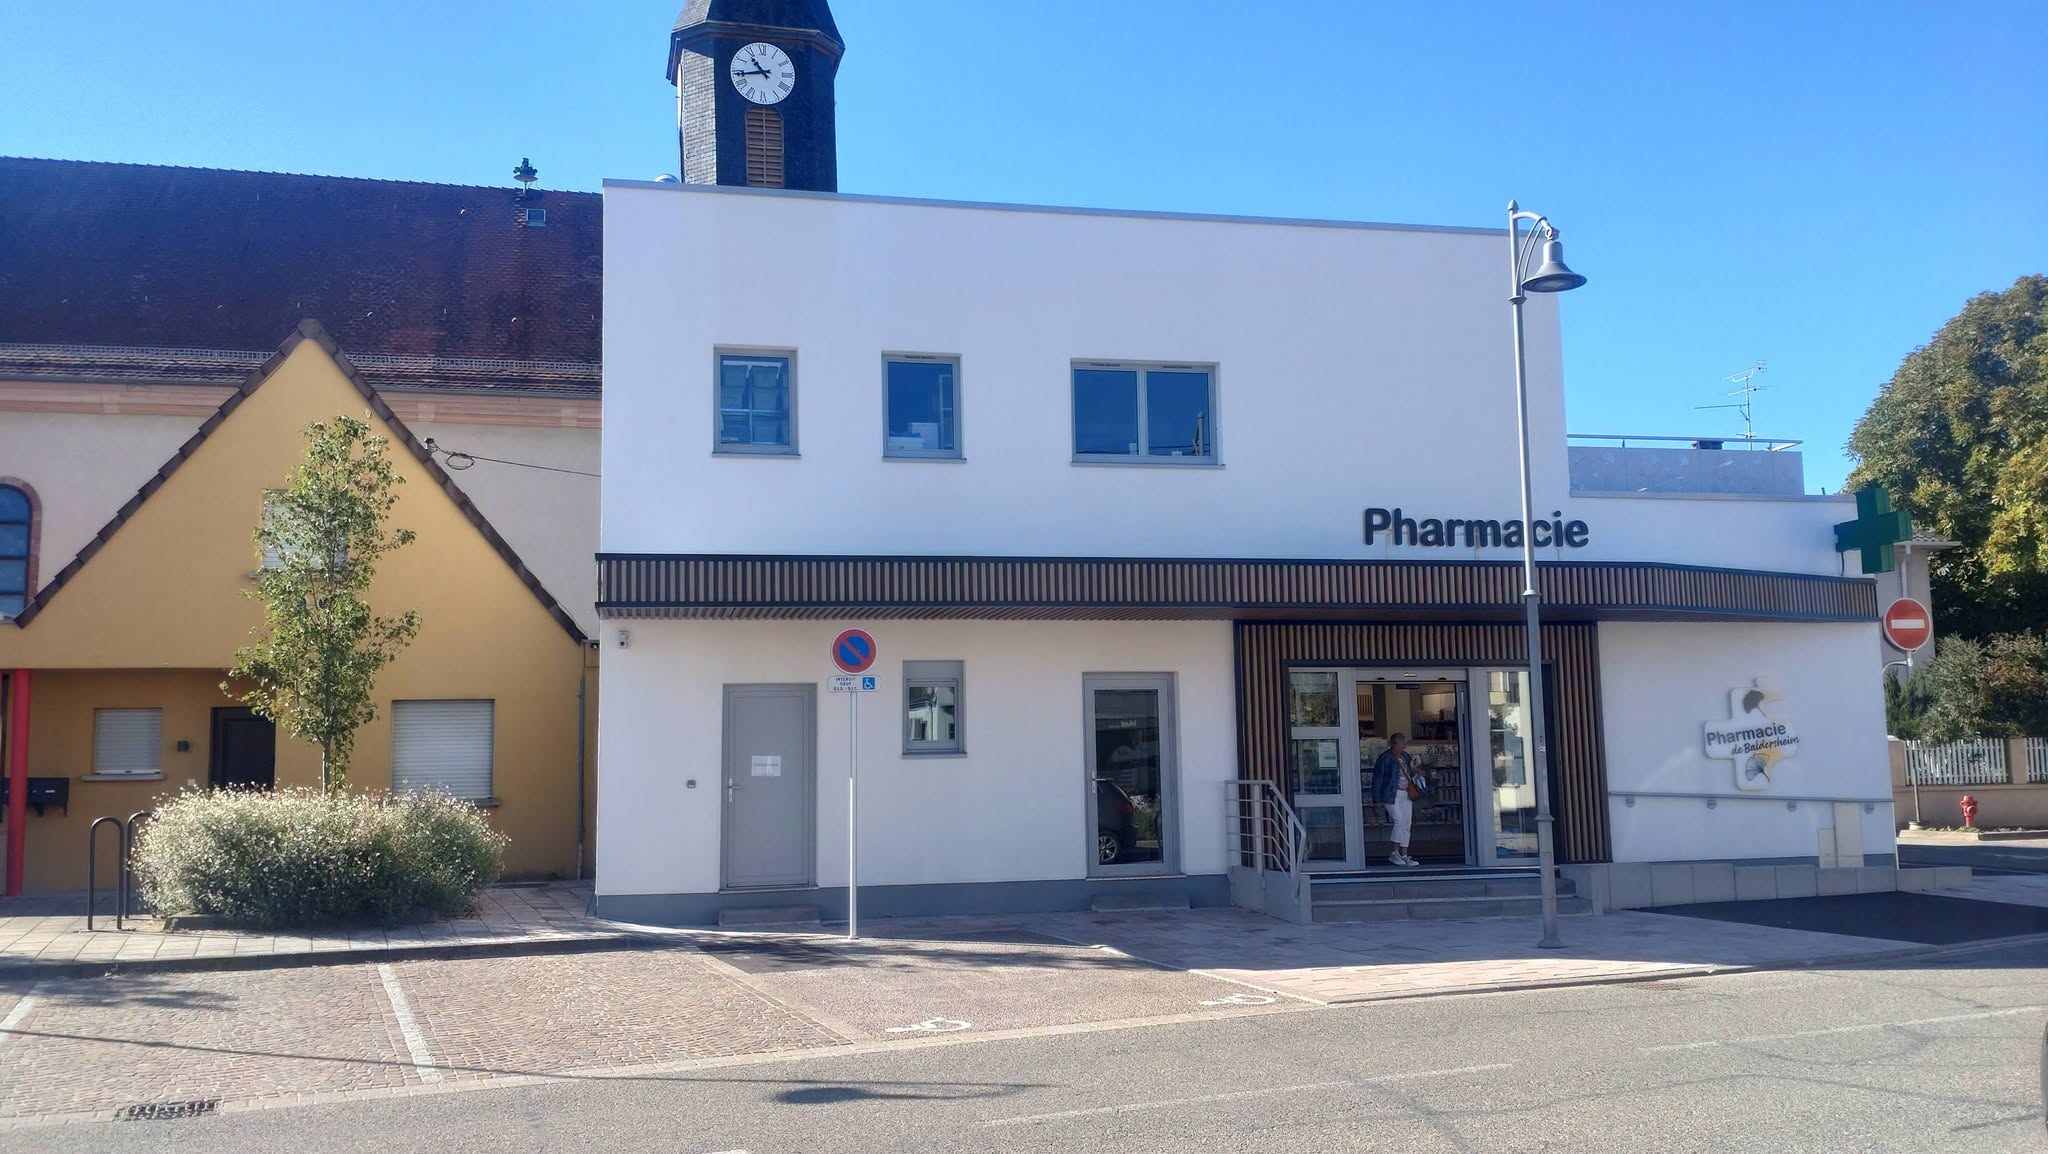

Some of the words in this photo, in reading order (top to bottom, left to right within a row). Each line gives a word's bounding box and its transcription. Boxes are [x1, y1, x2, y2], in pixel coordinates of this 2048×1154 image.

[1364, 507, 1589, 548] Pharmacie
[1706, 723, 1786, 746] Pharmacie
[1732, 743, 1743, 755] de
[1743, 736, 1800, 754] Baldersheim
